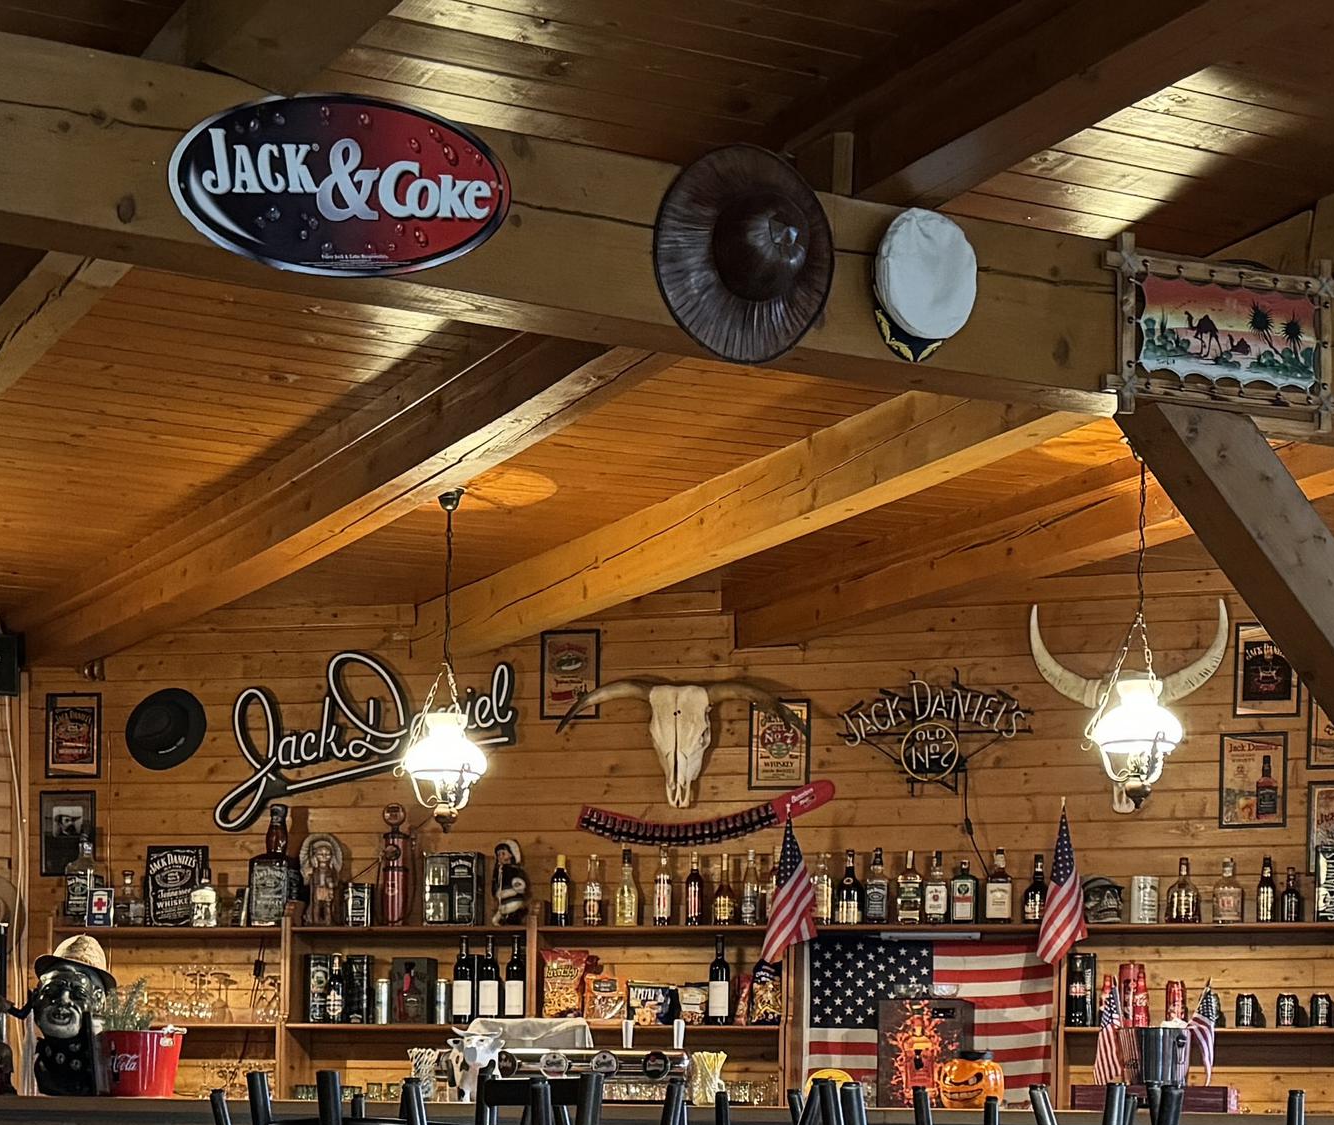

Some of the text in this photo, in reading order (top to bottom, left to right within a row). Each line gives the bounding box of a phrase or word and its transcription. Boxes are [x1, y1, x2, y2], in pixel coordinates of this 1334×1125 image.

[201, 128, 322, 195] JACK
[316, 137, 381, 223] &
[215, 653, 514, 830] Jack Diel
[843, 679, 1026, 748] JACK DANIEL'S
[915, 728, 947, 742] OLD
[148, 852, 198, 875] JACK DANIEL'S
